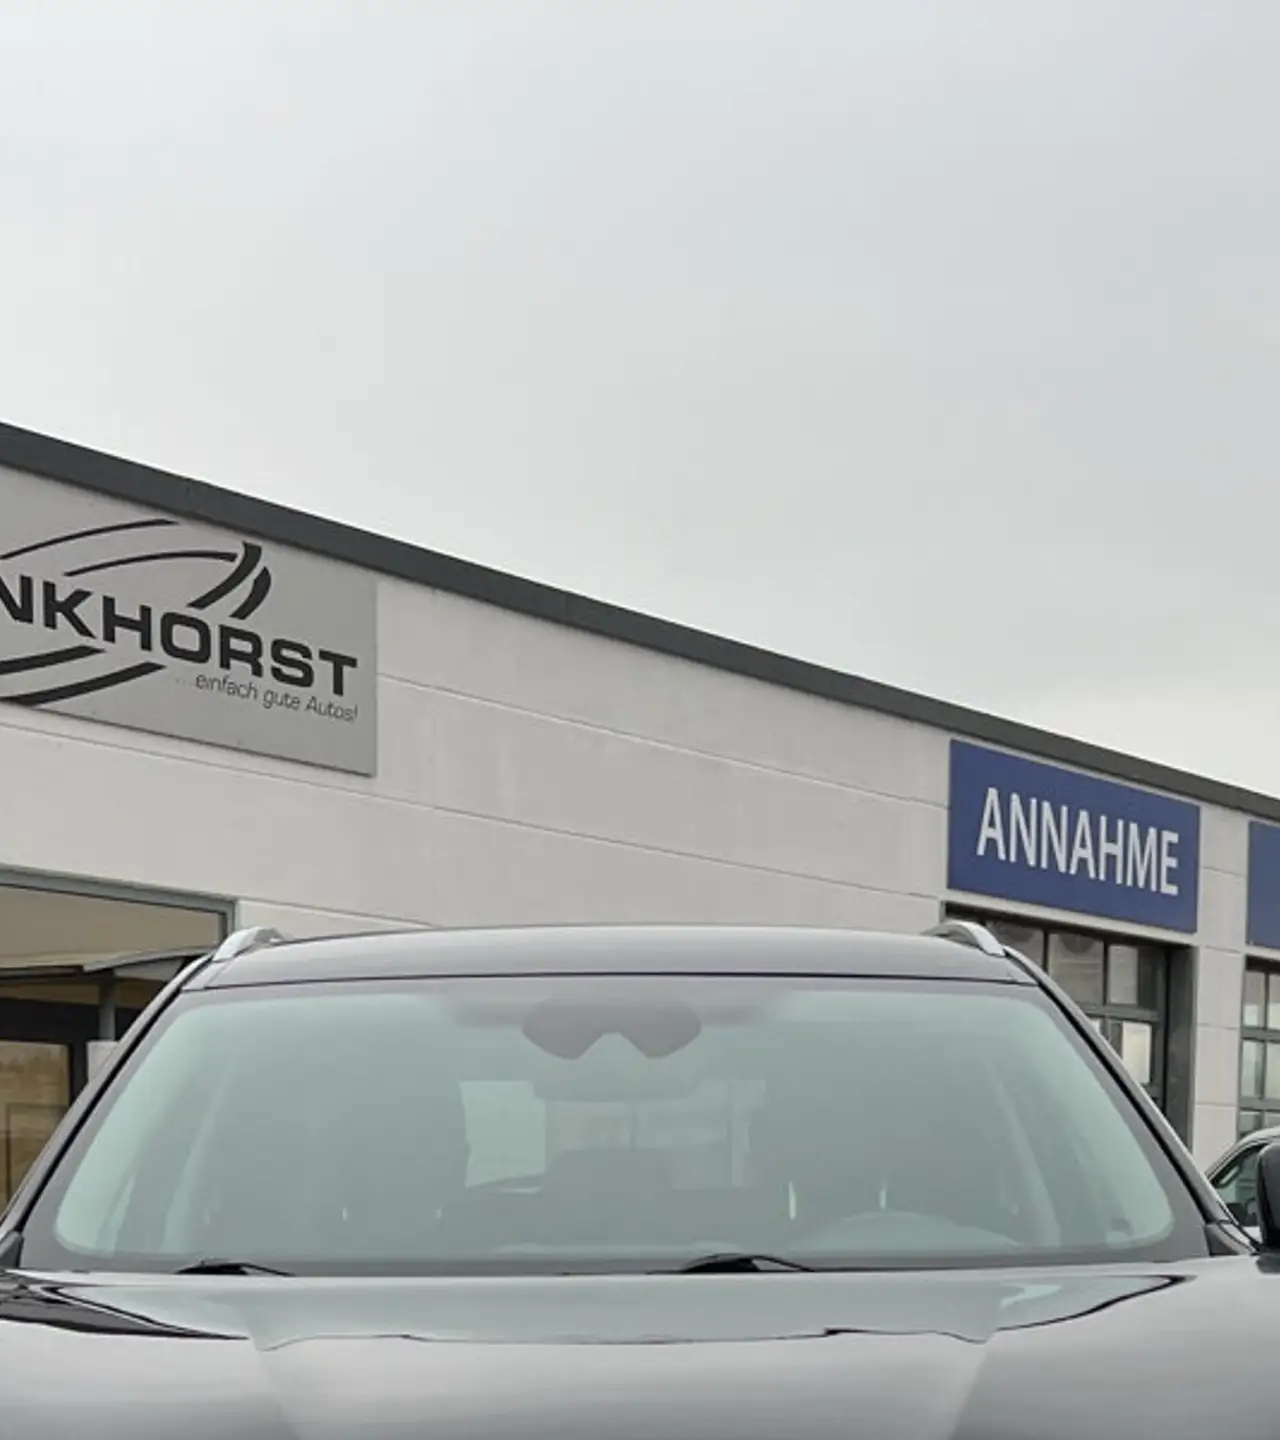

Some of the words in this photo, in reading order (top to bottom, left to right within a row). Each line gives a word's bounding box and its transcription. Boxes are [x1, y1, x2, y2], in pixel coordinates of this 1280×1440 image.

[262, 687, 301, 710] gute
[305, 693, 359, 724] Autos!
[976, 786, 1180, 897] ANNAHME
